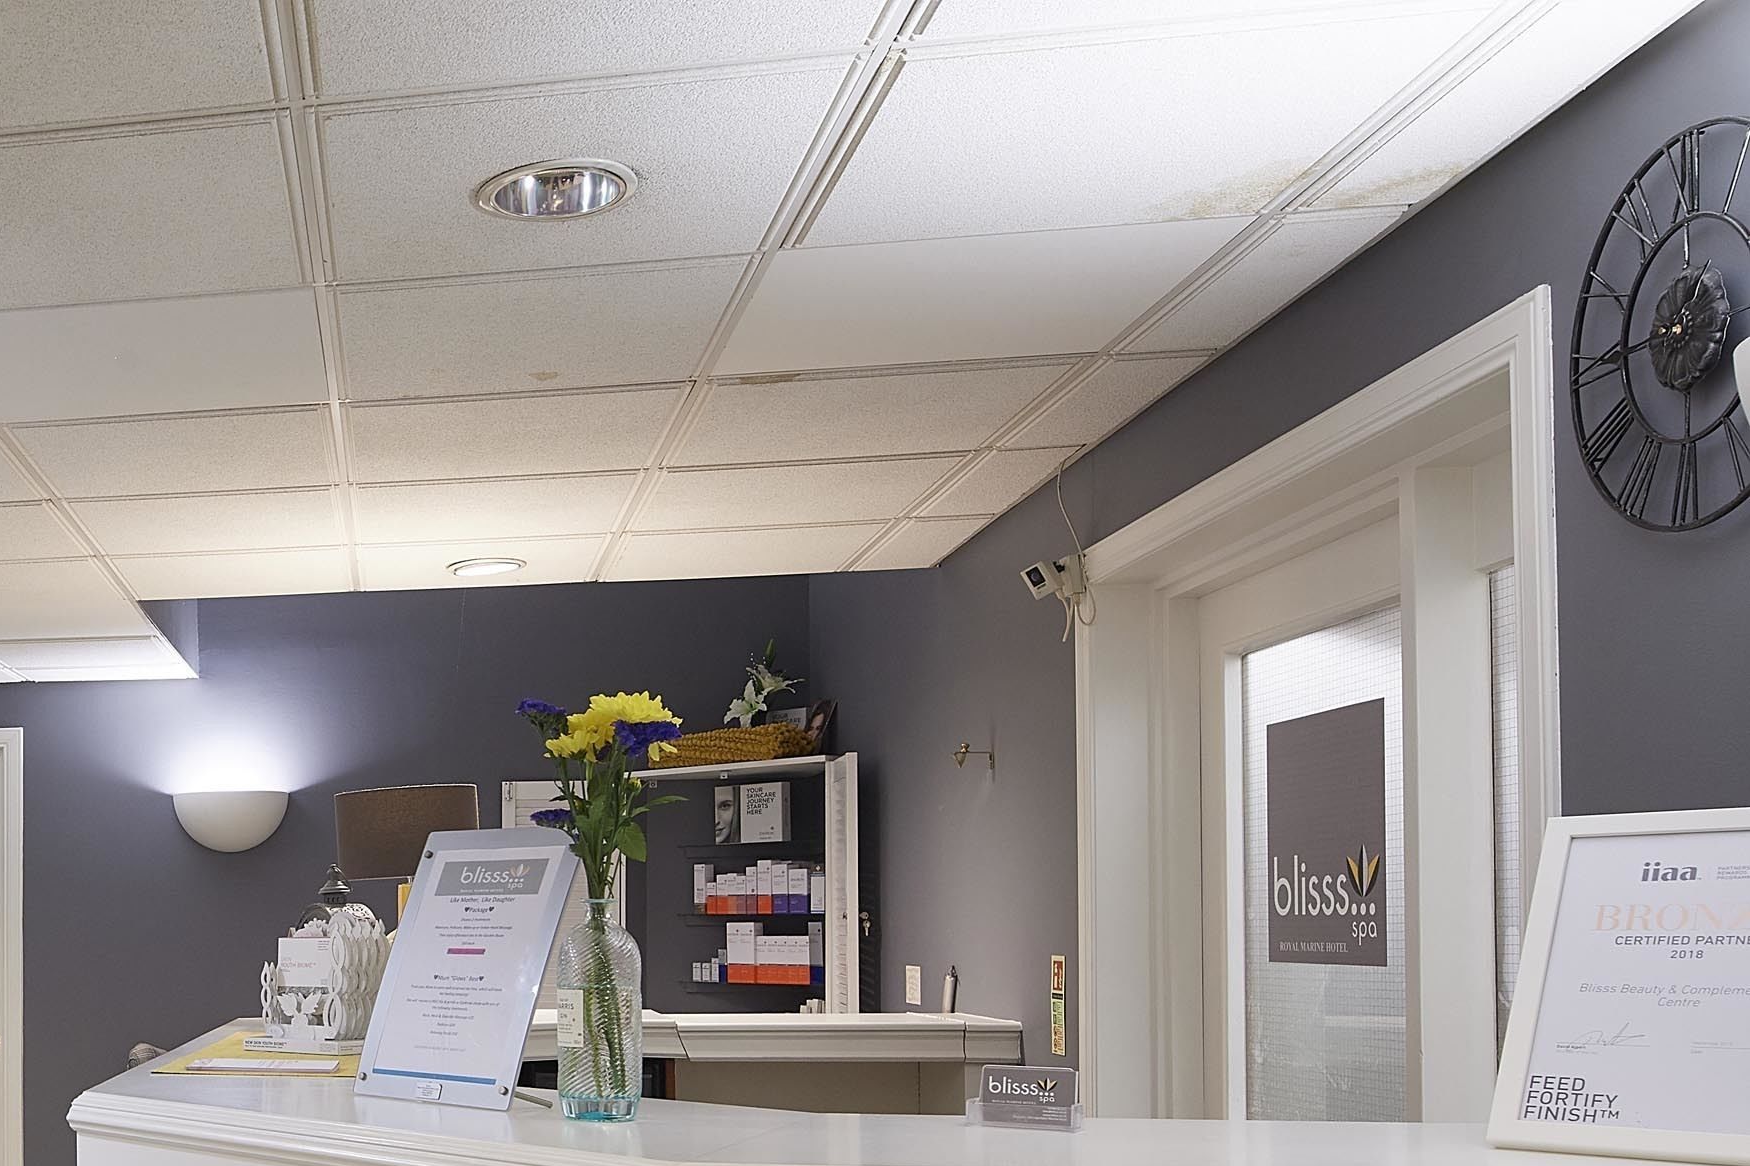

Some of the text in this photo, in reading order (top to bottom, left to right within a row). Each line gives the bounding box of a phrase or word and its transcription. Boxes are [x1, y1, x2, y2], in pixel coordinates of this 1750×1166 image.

[492, 896, 516, 904] Daughter
[1352, 921, 1377, 946] spa
[1615, 936, 1690, 945] CERTIFIED
[1279, 941, 1348, 953] ROYAL MARINE HOTEL
[1670, 950, 1704, 959] 2018
[1579, 983, 1617, 993] Blisss
[1620, 983, 1664, 996] Beauty
[1668, 985, 1677, 994] &
[1657, 997, 1700, 1008] Centre
[1529, 1075, 1586, 1092] FEED
[1039, 1096, 1055, 1104] spa
[1527, 1091, 1618, 1109] FORTIFY
